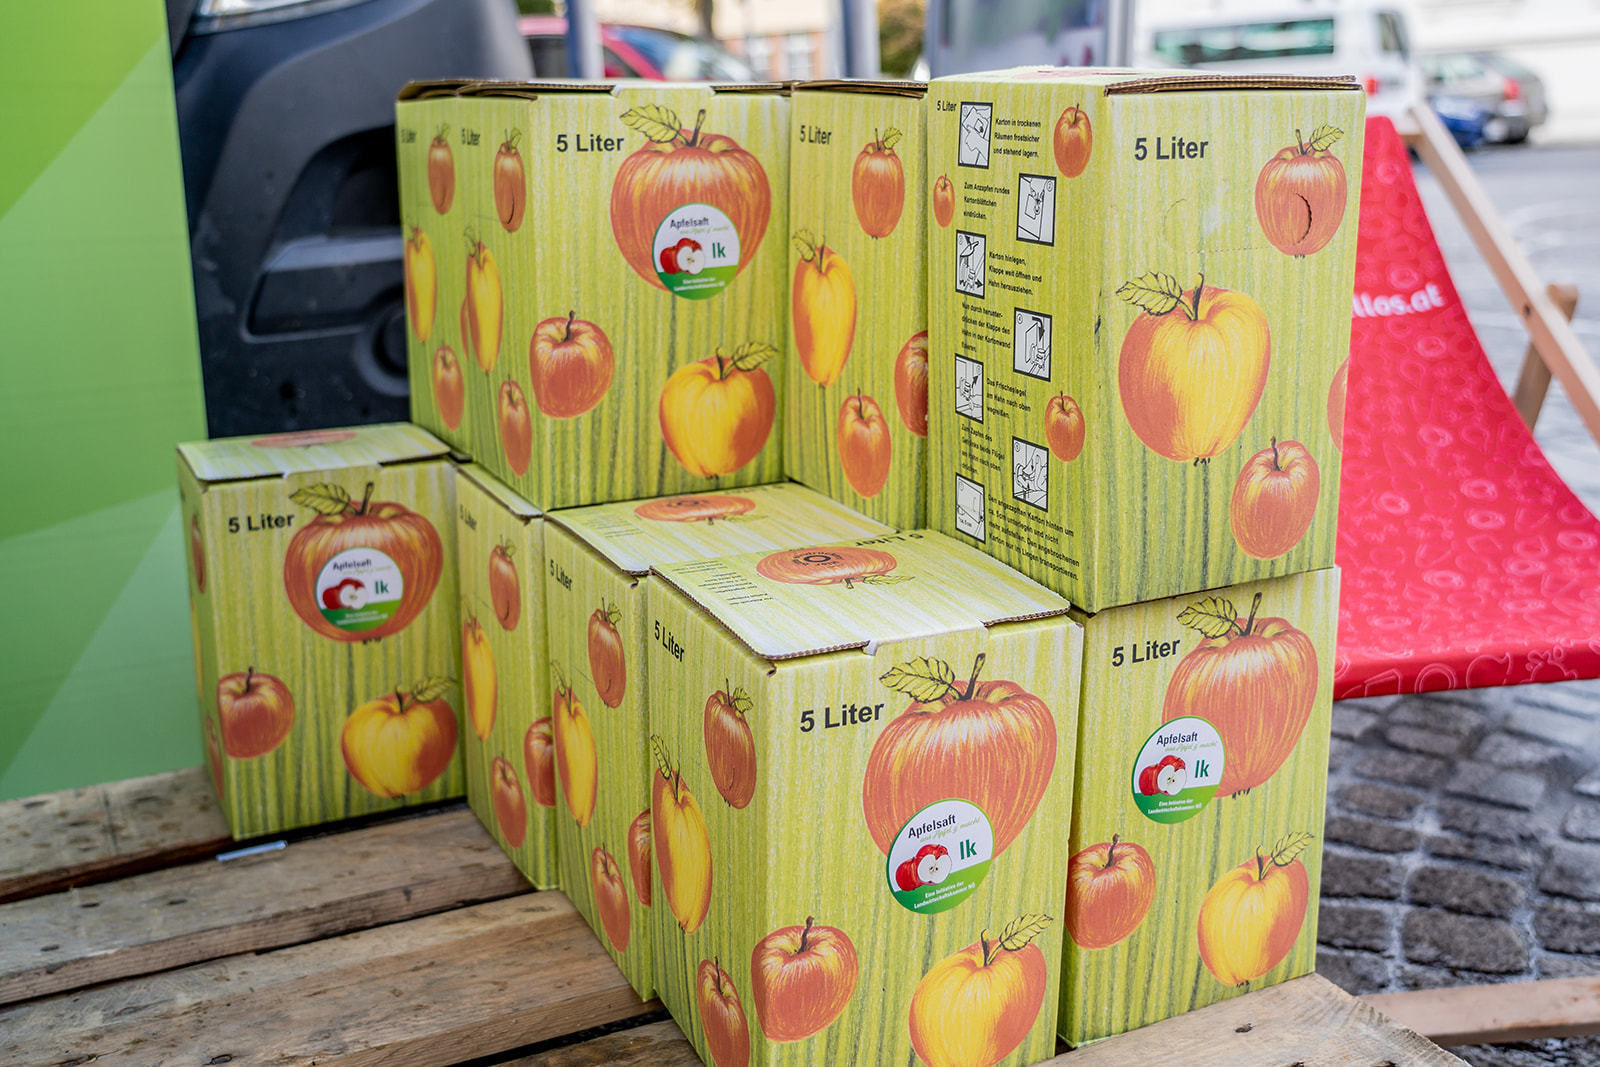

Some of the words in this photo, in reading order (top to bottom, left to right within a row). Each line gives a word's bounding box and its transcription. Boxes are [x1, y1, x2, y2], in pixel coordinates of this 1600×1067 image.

[937, 100, 941, 111] 5
[942, 102, 956, 112] Liter
[467, 128, 480, 146] Liter
[556, 134, 568, 152] 5
[576, 134, 624, 152] Liter
[800, 124, 806, 142] 5
[808, 126, 832, 144] Liter
[1135, 138, 1147, 160] 5
[1157, 136, 1208, 159] Liter
[670, 217, 709, 229] Apfelsaft
[1352, 282, 1445, 318] llos.at
[228, 516, 240, 533] 5
[247, 514, 295, 531] Liter
[550, 559, 554, 576] 5
[556, 564, 572, 591] Liter
[655, 620, 660, 640] 5
[662, 626, 684, 662] Liter
[1112, 646, 1124, 667] 5
[1132, 640, 1180, 663] Liter
[800, 710, 815, 732] 5
[824, 703, 885, 728] Liter
[1157, 732, 1198, 746] Apfelsaft
[908, 814, 956, 839] Apfelsaft
